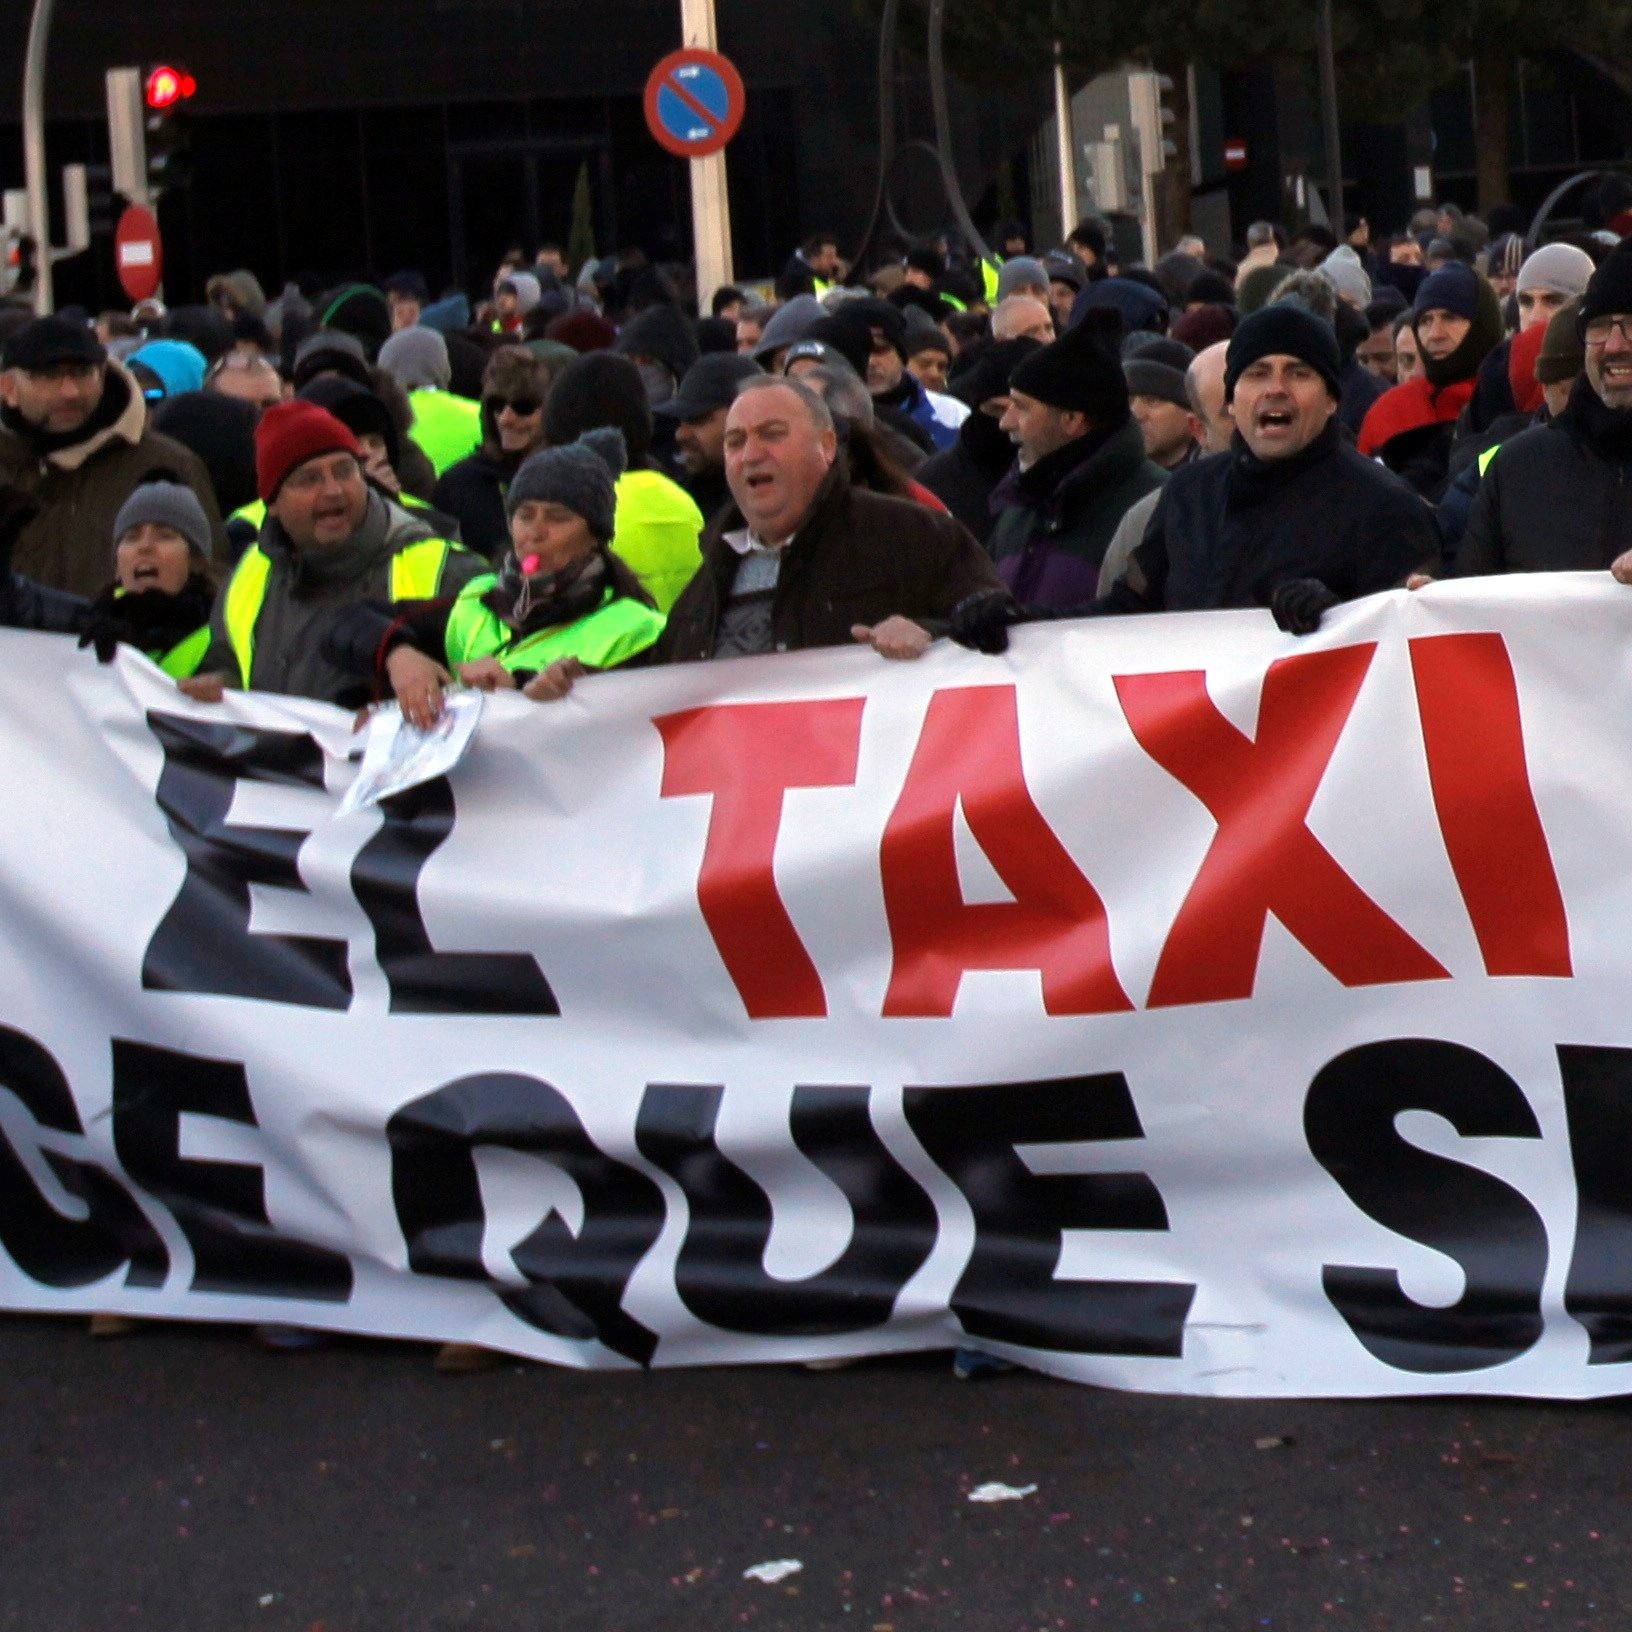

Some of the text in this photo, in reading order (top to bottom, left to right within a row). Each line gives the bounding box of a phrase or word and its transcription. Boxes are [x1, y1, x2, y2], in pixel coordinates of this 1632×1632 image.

[142, 711, 561, 1017] EL
[655, 633, 1574, 1019] TAXI
[386, 1072, 1195, 1368] QUE
